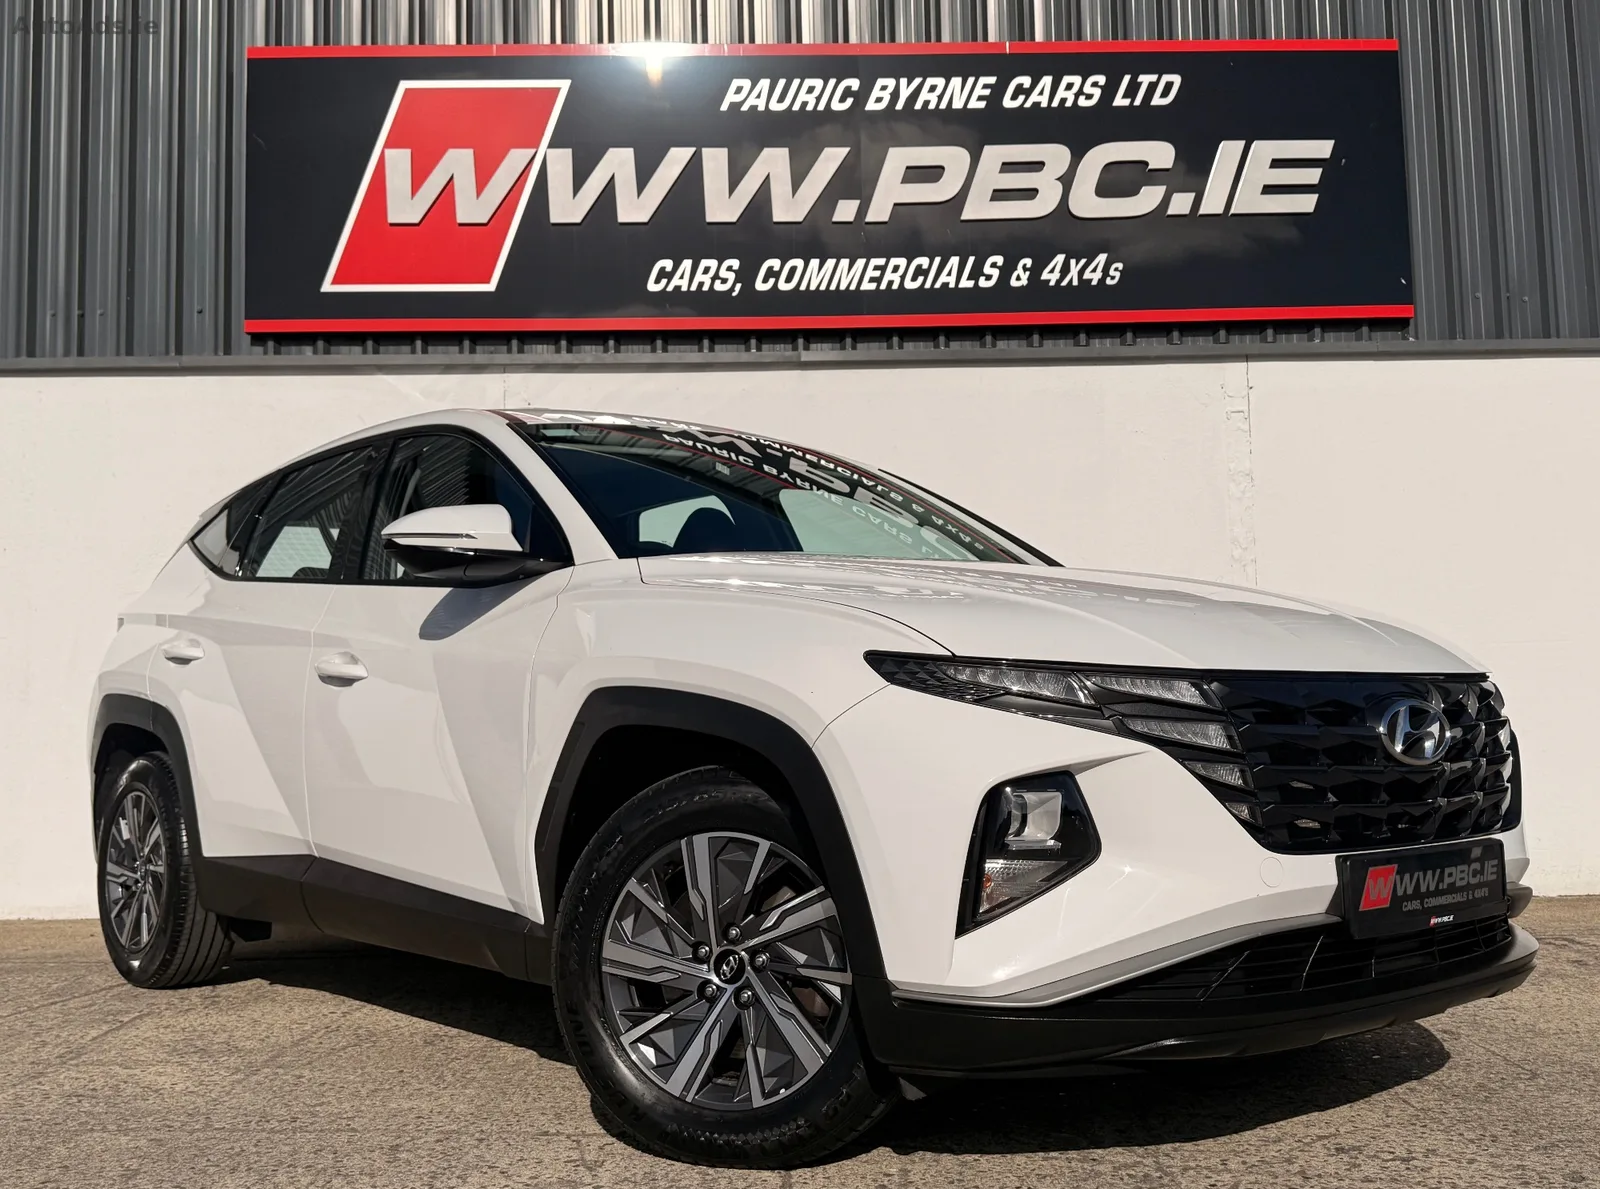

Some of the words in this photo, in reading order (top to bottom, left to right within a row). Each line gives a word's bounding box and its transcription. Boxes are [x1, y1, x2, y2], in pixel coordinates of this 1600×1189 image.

[720, 77, 861, 112] PAURIC
[865, 76, 998, 111] BYRNE
[1003, 75, 1107, 109] CARS
[1113, 74, 1182, 107] LTD
[647, 258, 742, 297] CARS,
[755, 255, 1004, 292] COMMERCIALS
[1010, 257, 1033, 287] &
[1424, 891, 1468, 908] COMMERCIALS
